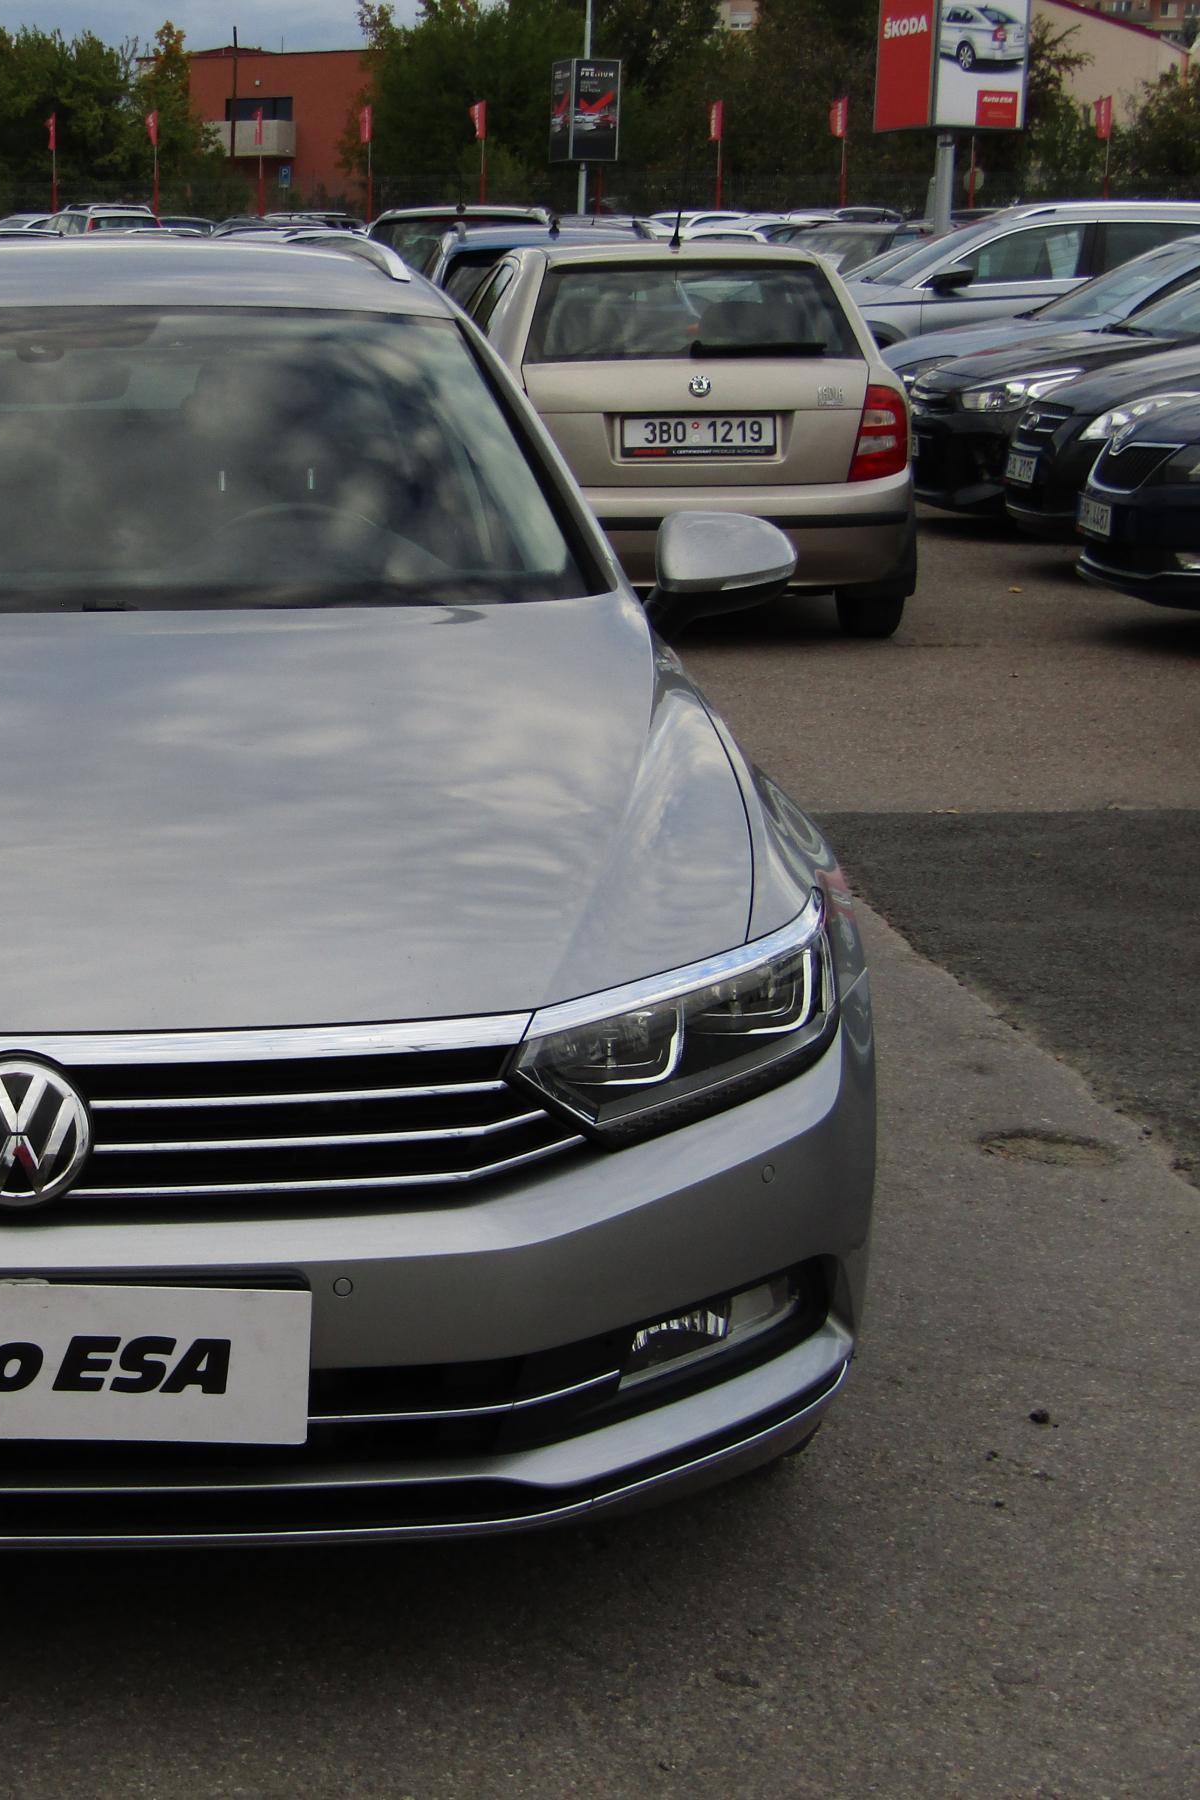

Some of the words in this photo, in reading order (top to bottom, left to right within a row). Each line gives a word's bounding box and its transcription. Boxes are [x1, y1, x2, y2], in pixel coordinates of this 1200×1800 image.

[884, 15, 928, 40] ŠKODA
[707, 420, 763, 443] 1219
[52, 1335, 232, 1395] ESA
